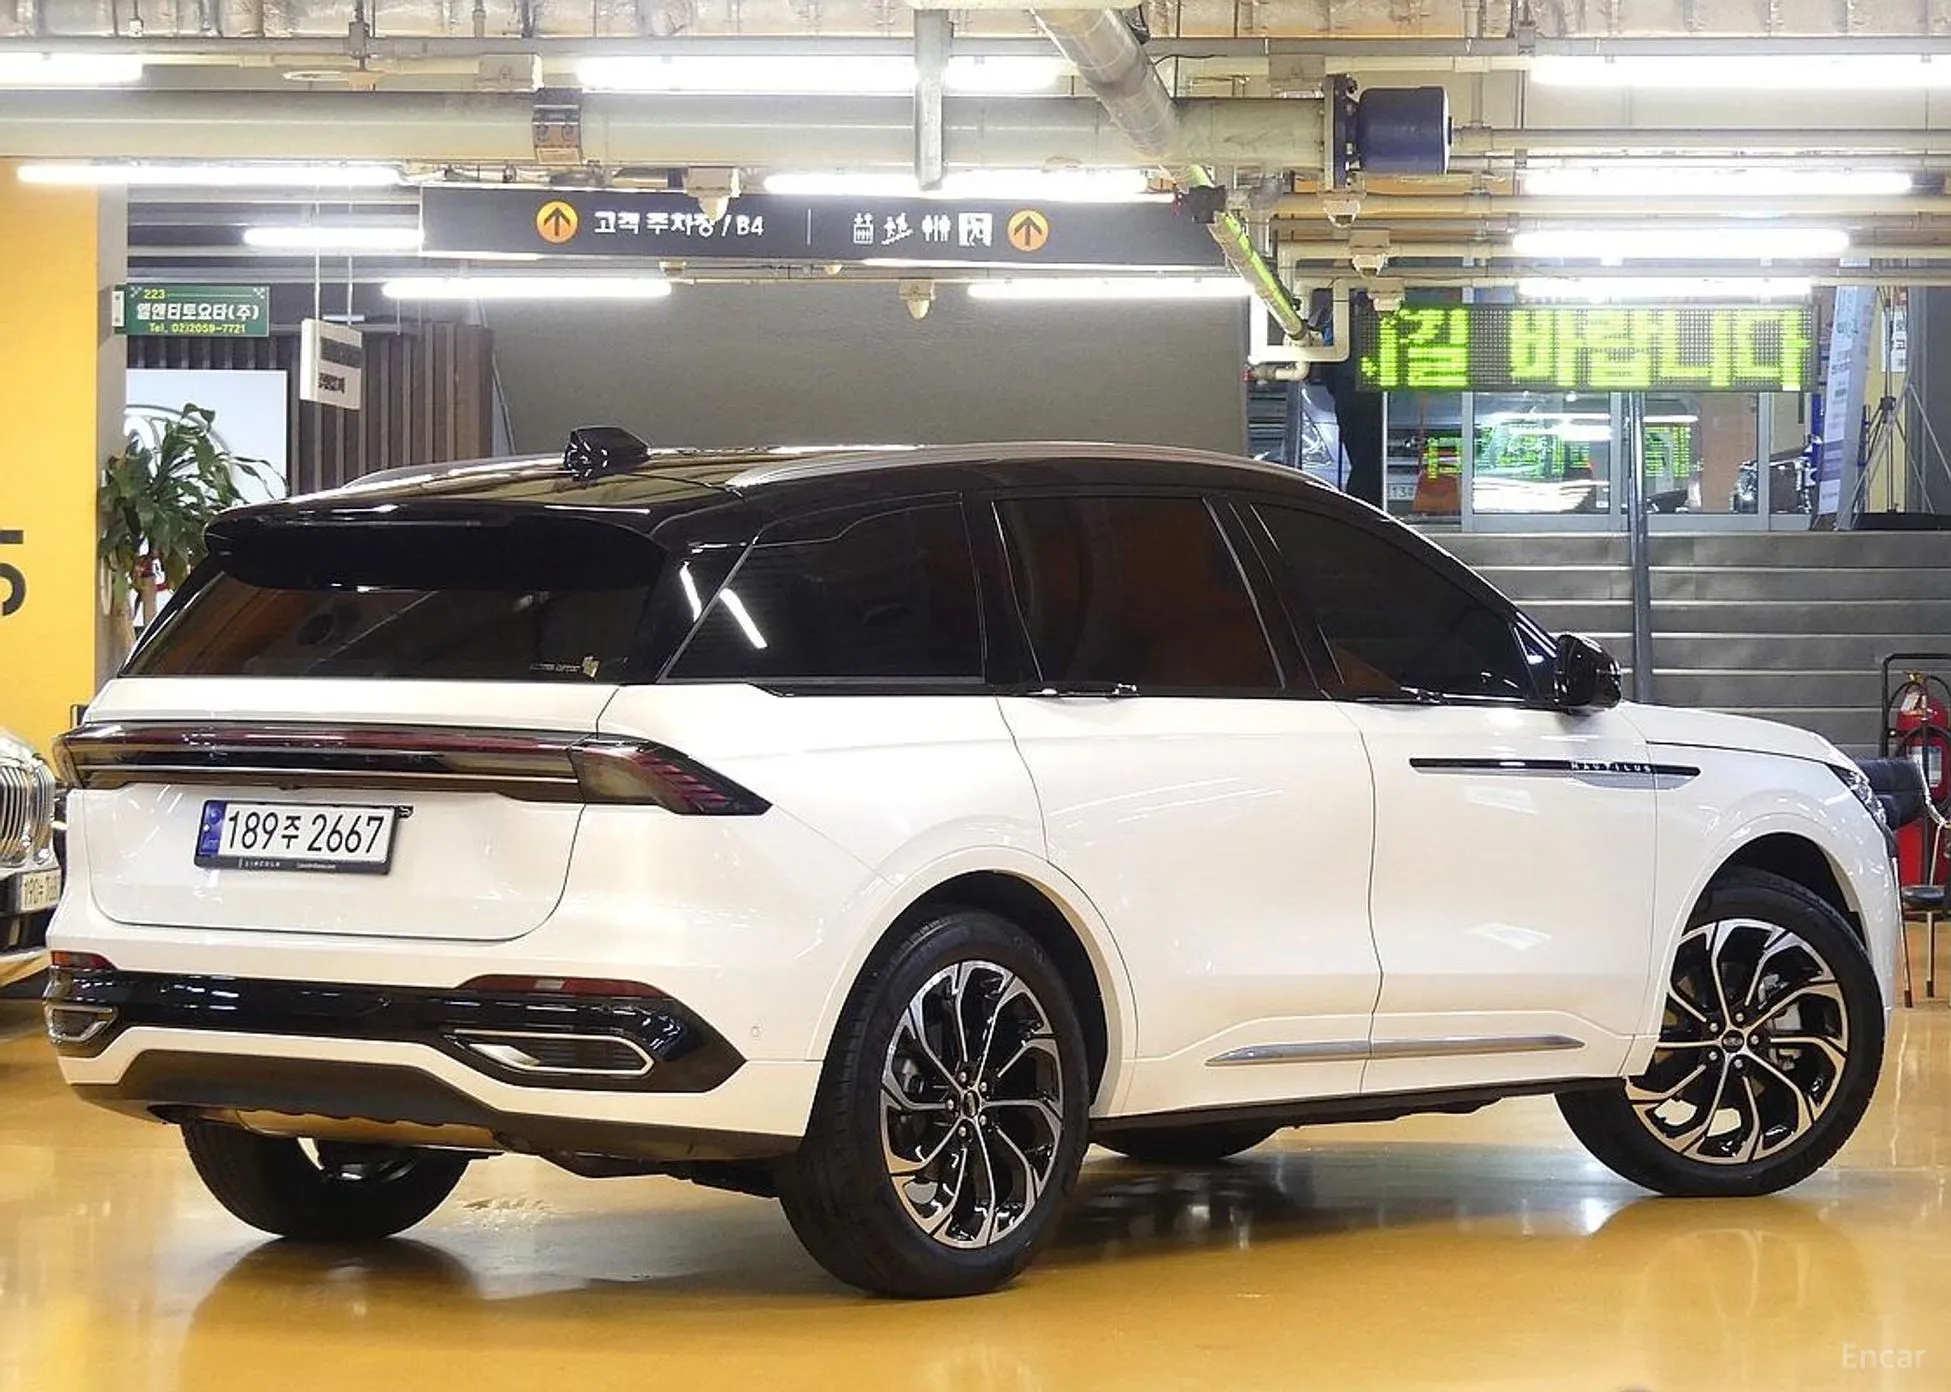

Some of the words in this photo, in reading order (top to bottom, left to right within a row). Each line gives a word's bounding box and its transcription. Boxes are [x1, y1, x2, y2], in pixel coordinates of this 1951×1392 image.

[594, 210, 641, 235] 고객
[736, 214, 764, 236] B4
[143, 289, 166, 300] 223
[1510, 308, 1812, 390] 바랍니다
[228, 809, 301, 850] 189주
[307, 813, 385, 854] 2667
